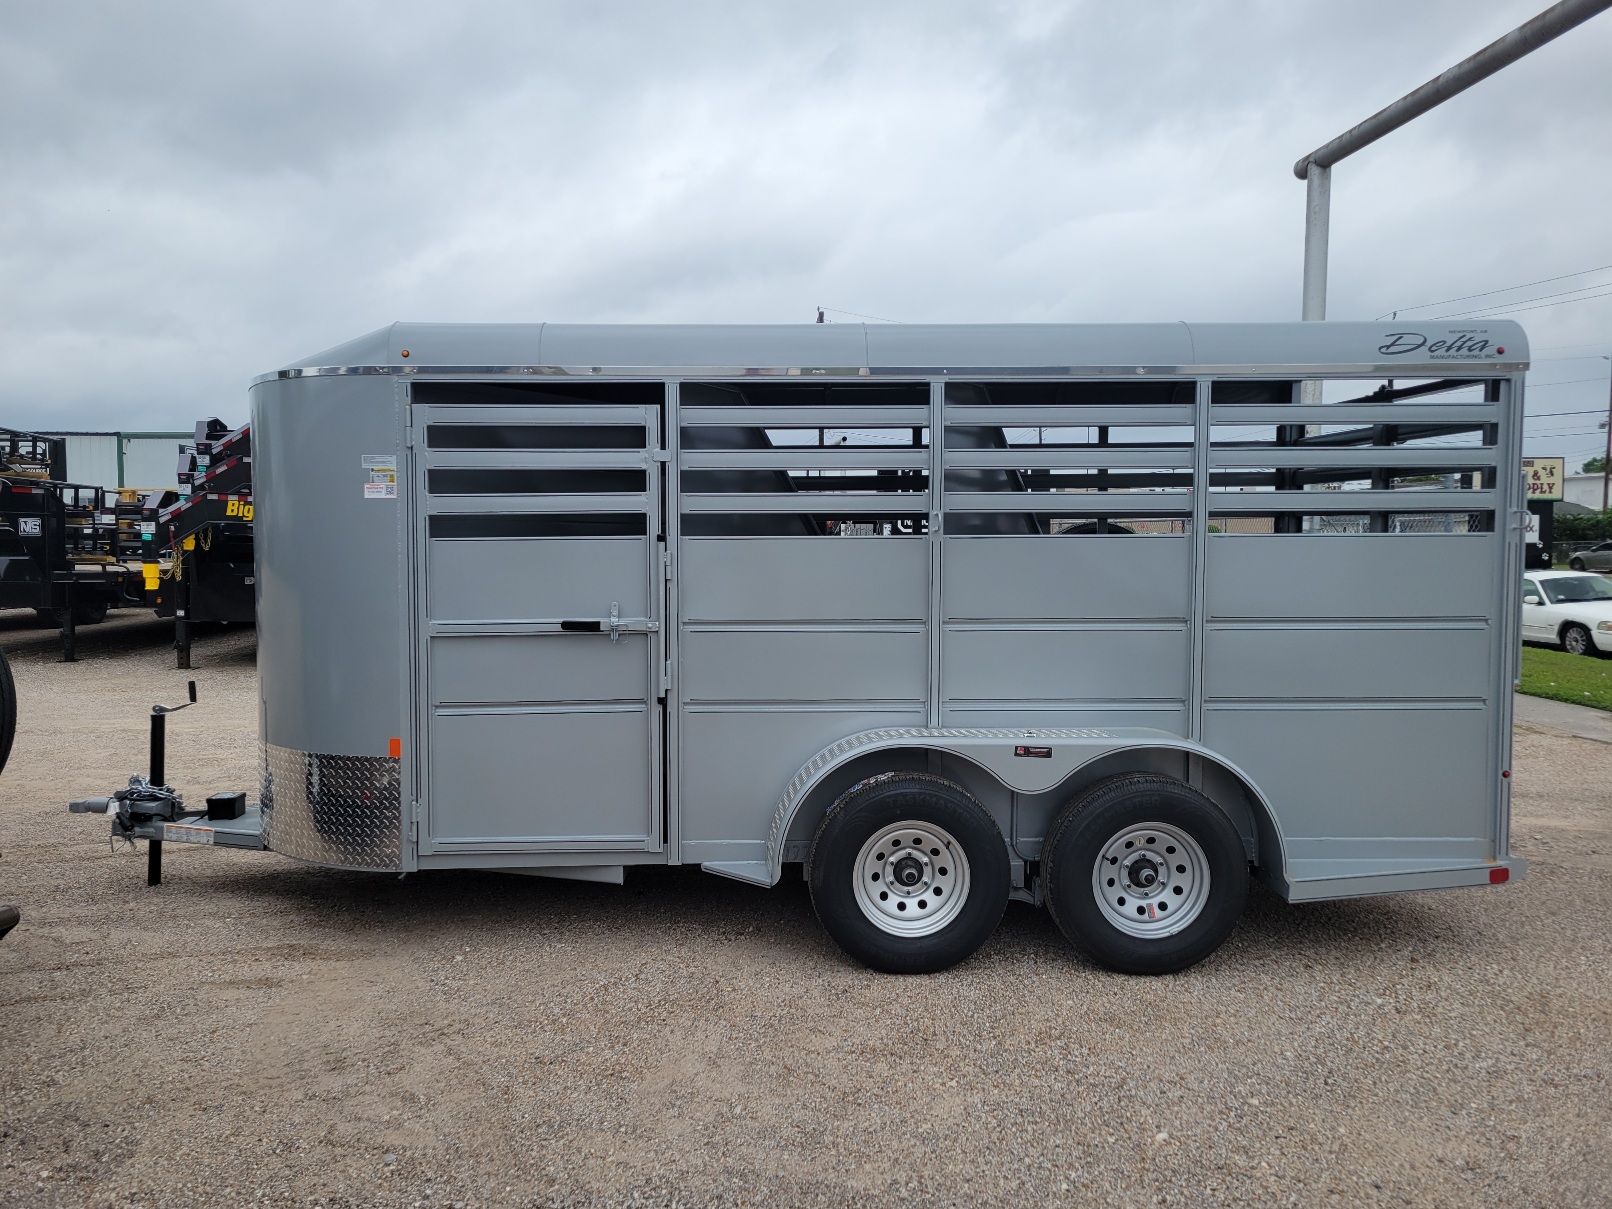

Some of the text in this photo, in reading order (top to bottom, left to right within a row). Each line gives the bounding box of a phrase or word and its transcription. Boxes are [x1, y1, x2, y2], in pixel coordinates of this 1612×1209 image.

[1378, 332, 1494, 355] Delta
[1532, 470, 1541, 481] &
[226, 500, 254, 520] Big
[885, 793, 978, 829] TASKMASTER
